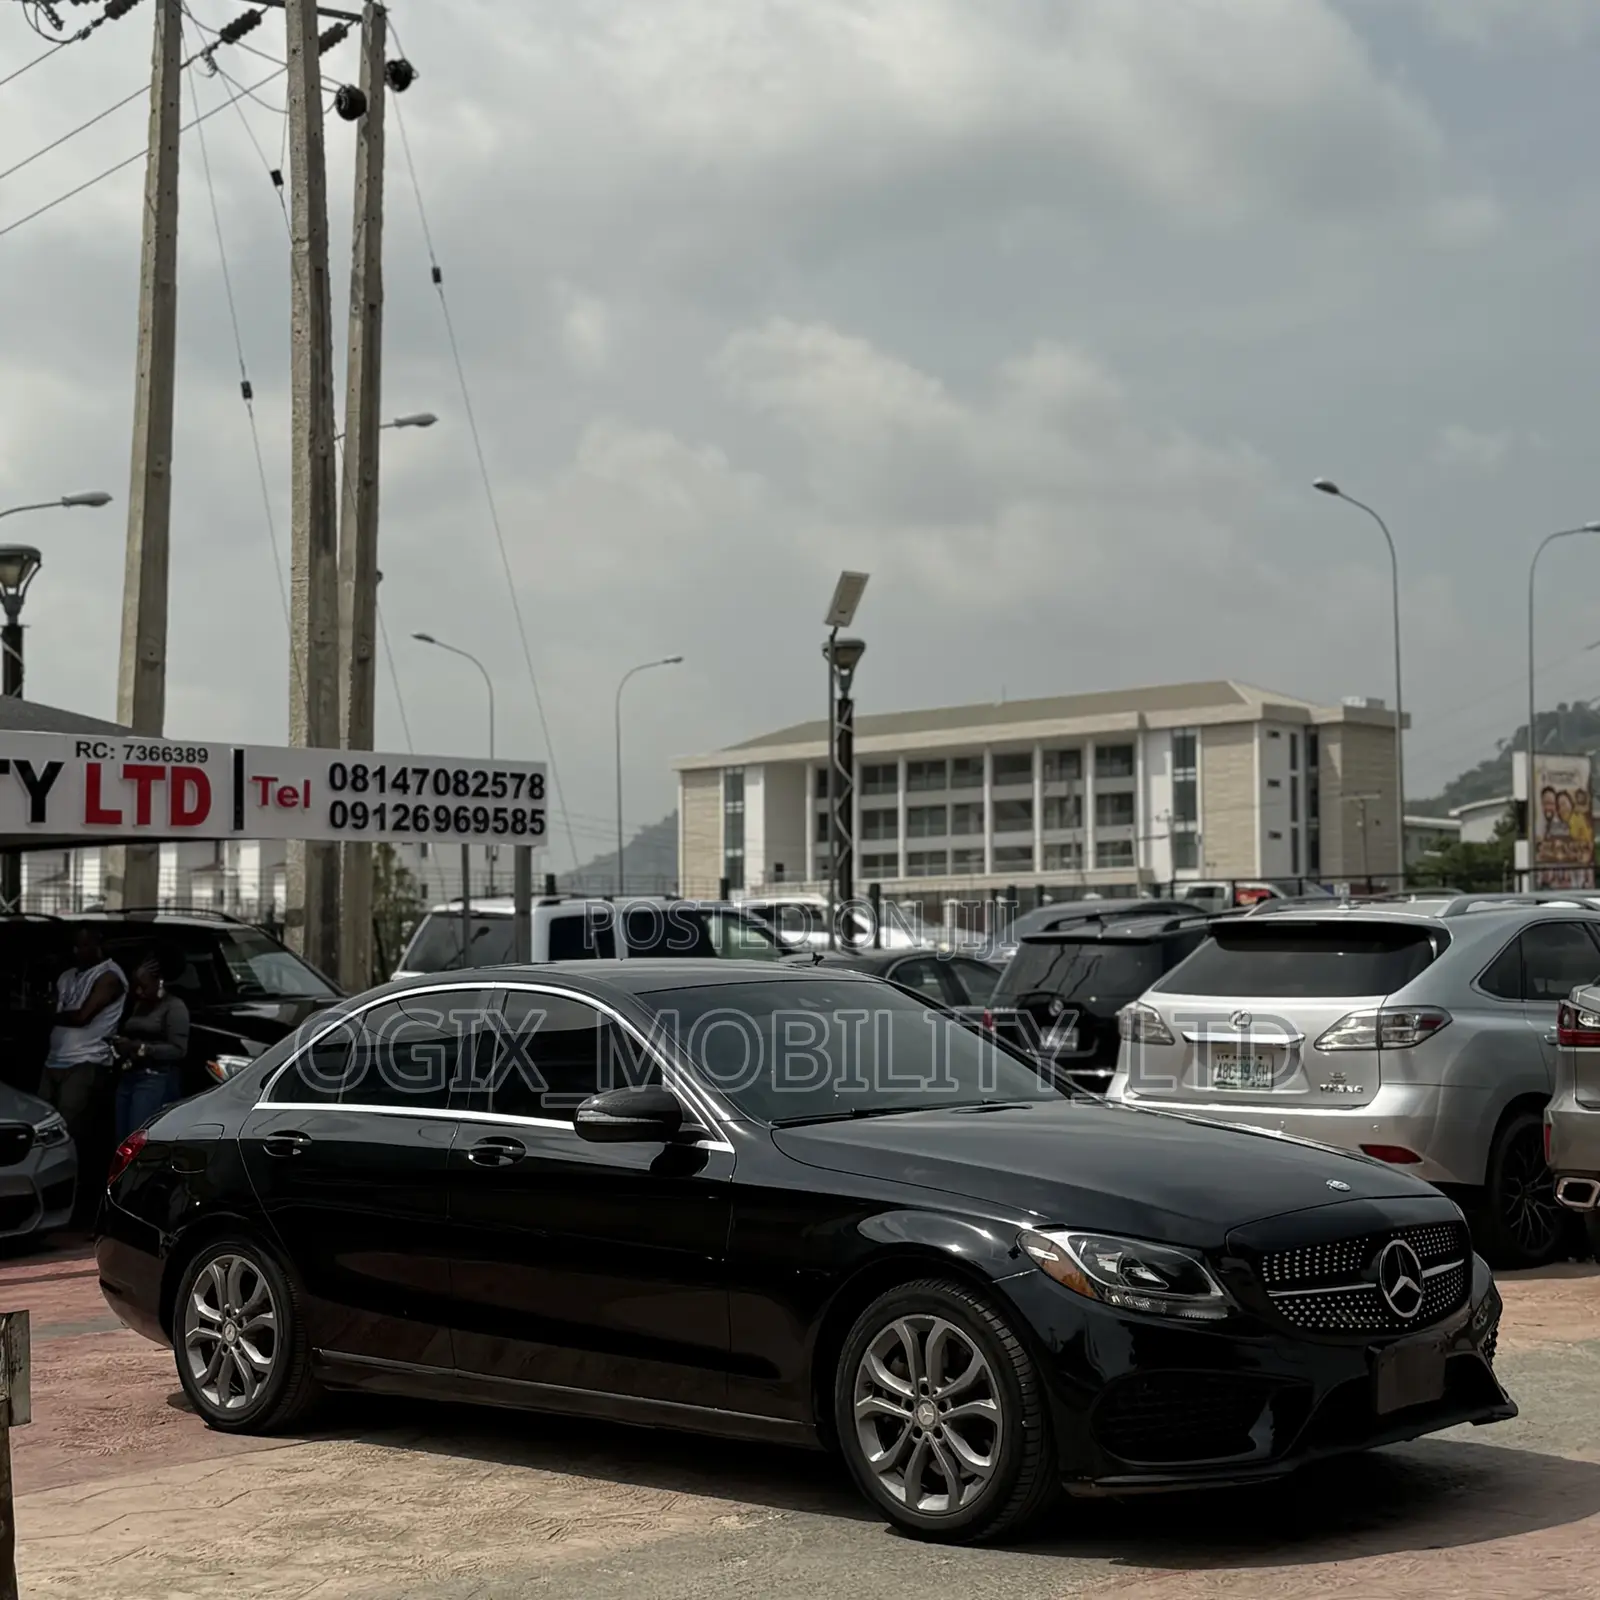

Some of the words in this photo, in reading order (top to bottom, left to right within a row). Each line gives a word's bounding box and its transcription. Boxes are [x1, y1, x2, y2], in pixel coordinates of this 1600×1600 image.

[75, 741, 115, 760] RC:
[123, 744, 208, 763] 7366389
[84, 762, 212, 827] LTD
[250, 775, 311, 809] Tel
[328, 762, 545, 800] 08147082578
[329, 800, 545, 835] 09126969585
